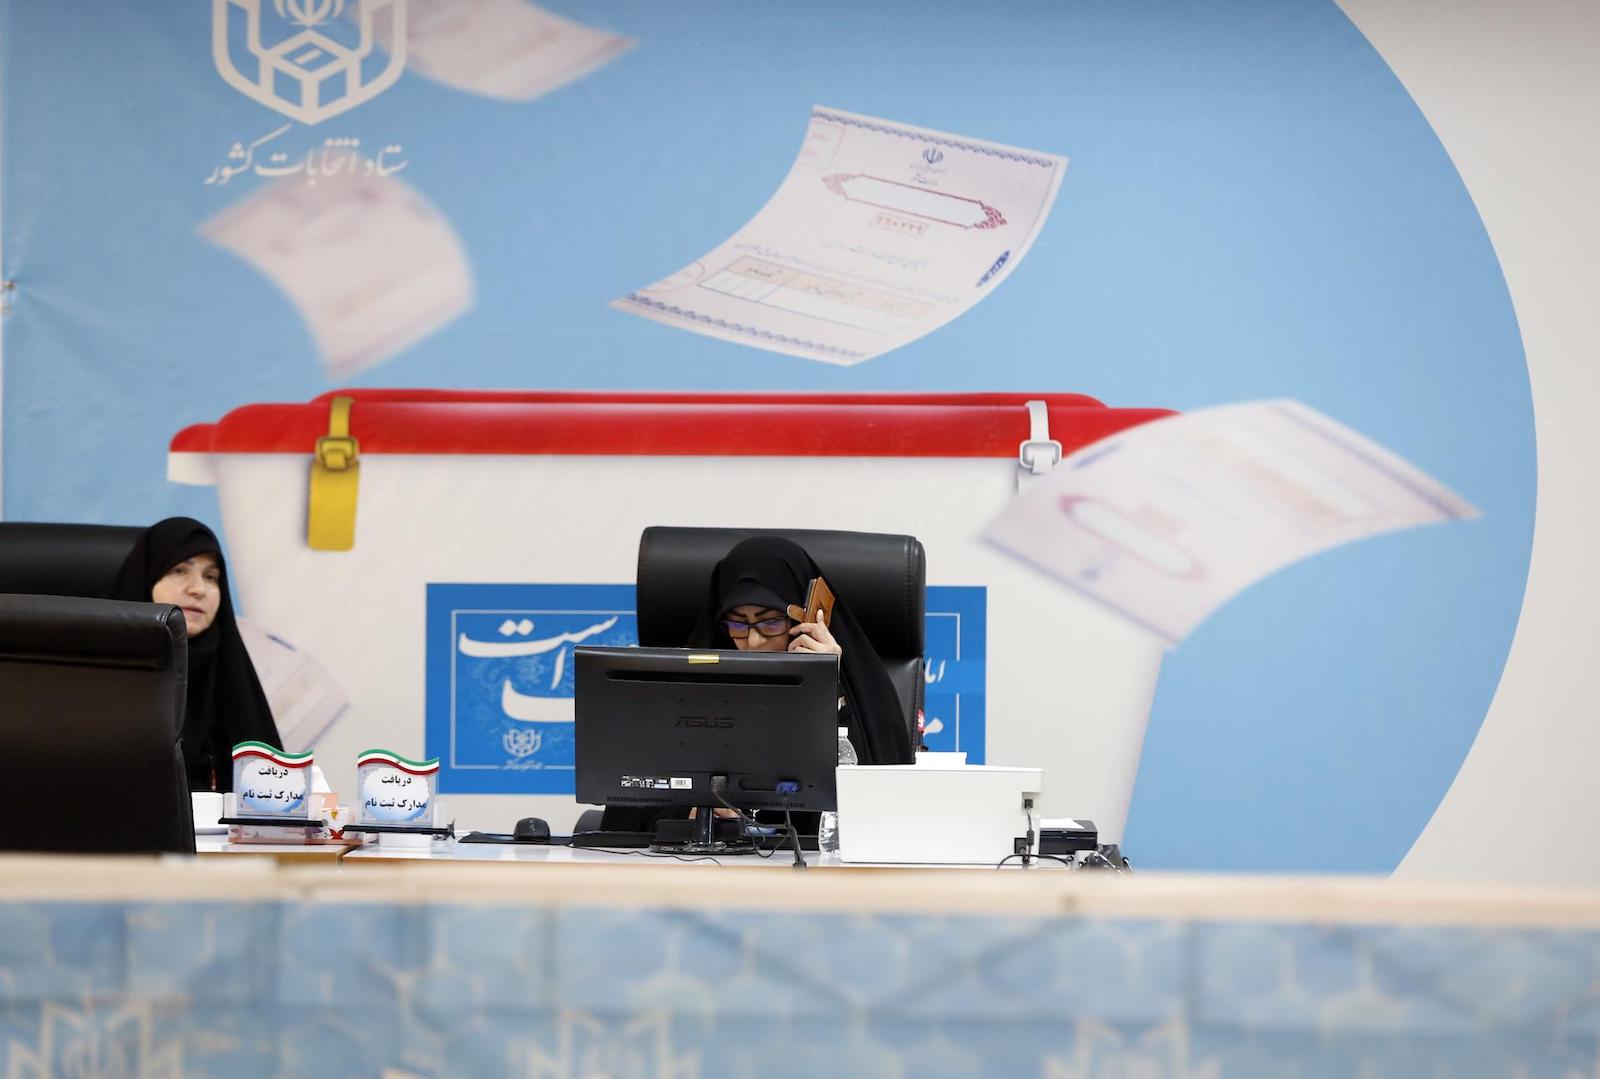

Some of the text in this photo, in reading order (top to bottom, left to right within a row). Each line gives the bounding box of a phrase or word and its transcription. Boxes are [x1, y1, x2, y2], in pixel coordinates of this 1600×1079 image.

[203, 122, 409, 187] ستاد انتخابات کشور
[673, 716, 734, 729] ASUS
[258, 765, 289, 779] دریافت
[381, 774, 412, 787] دریافت
[242, 788, 304, 803] مدارک ثبت نام
[364, 796, 428, 811] مدارک ثبت نام
